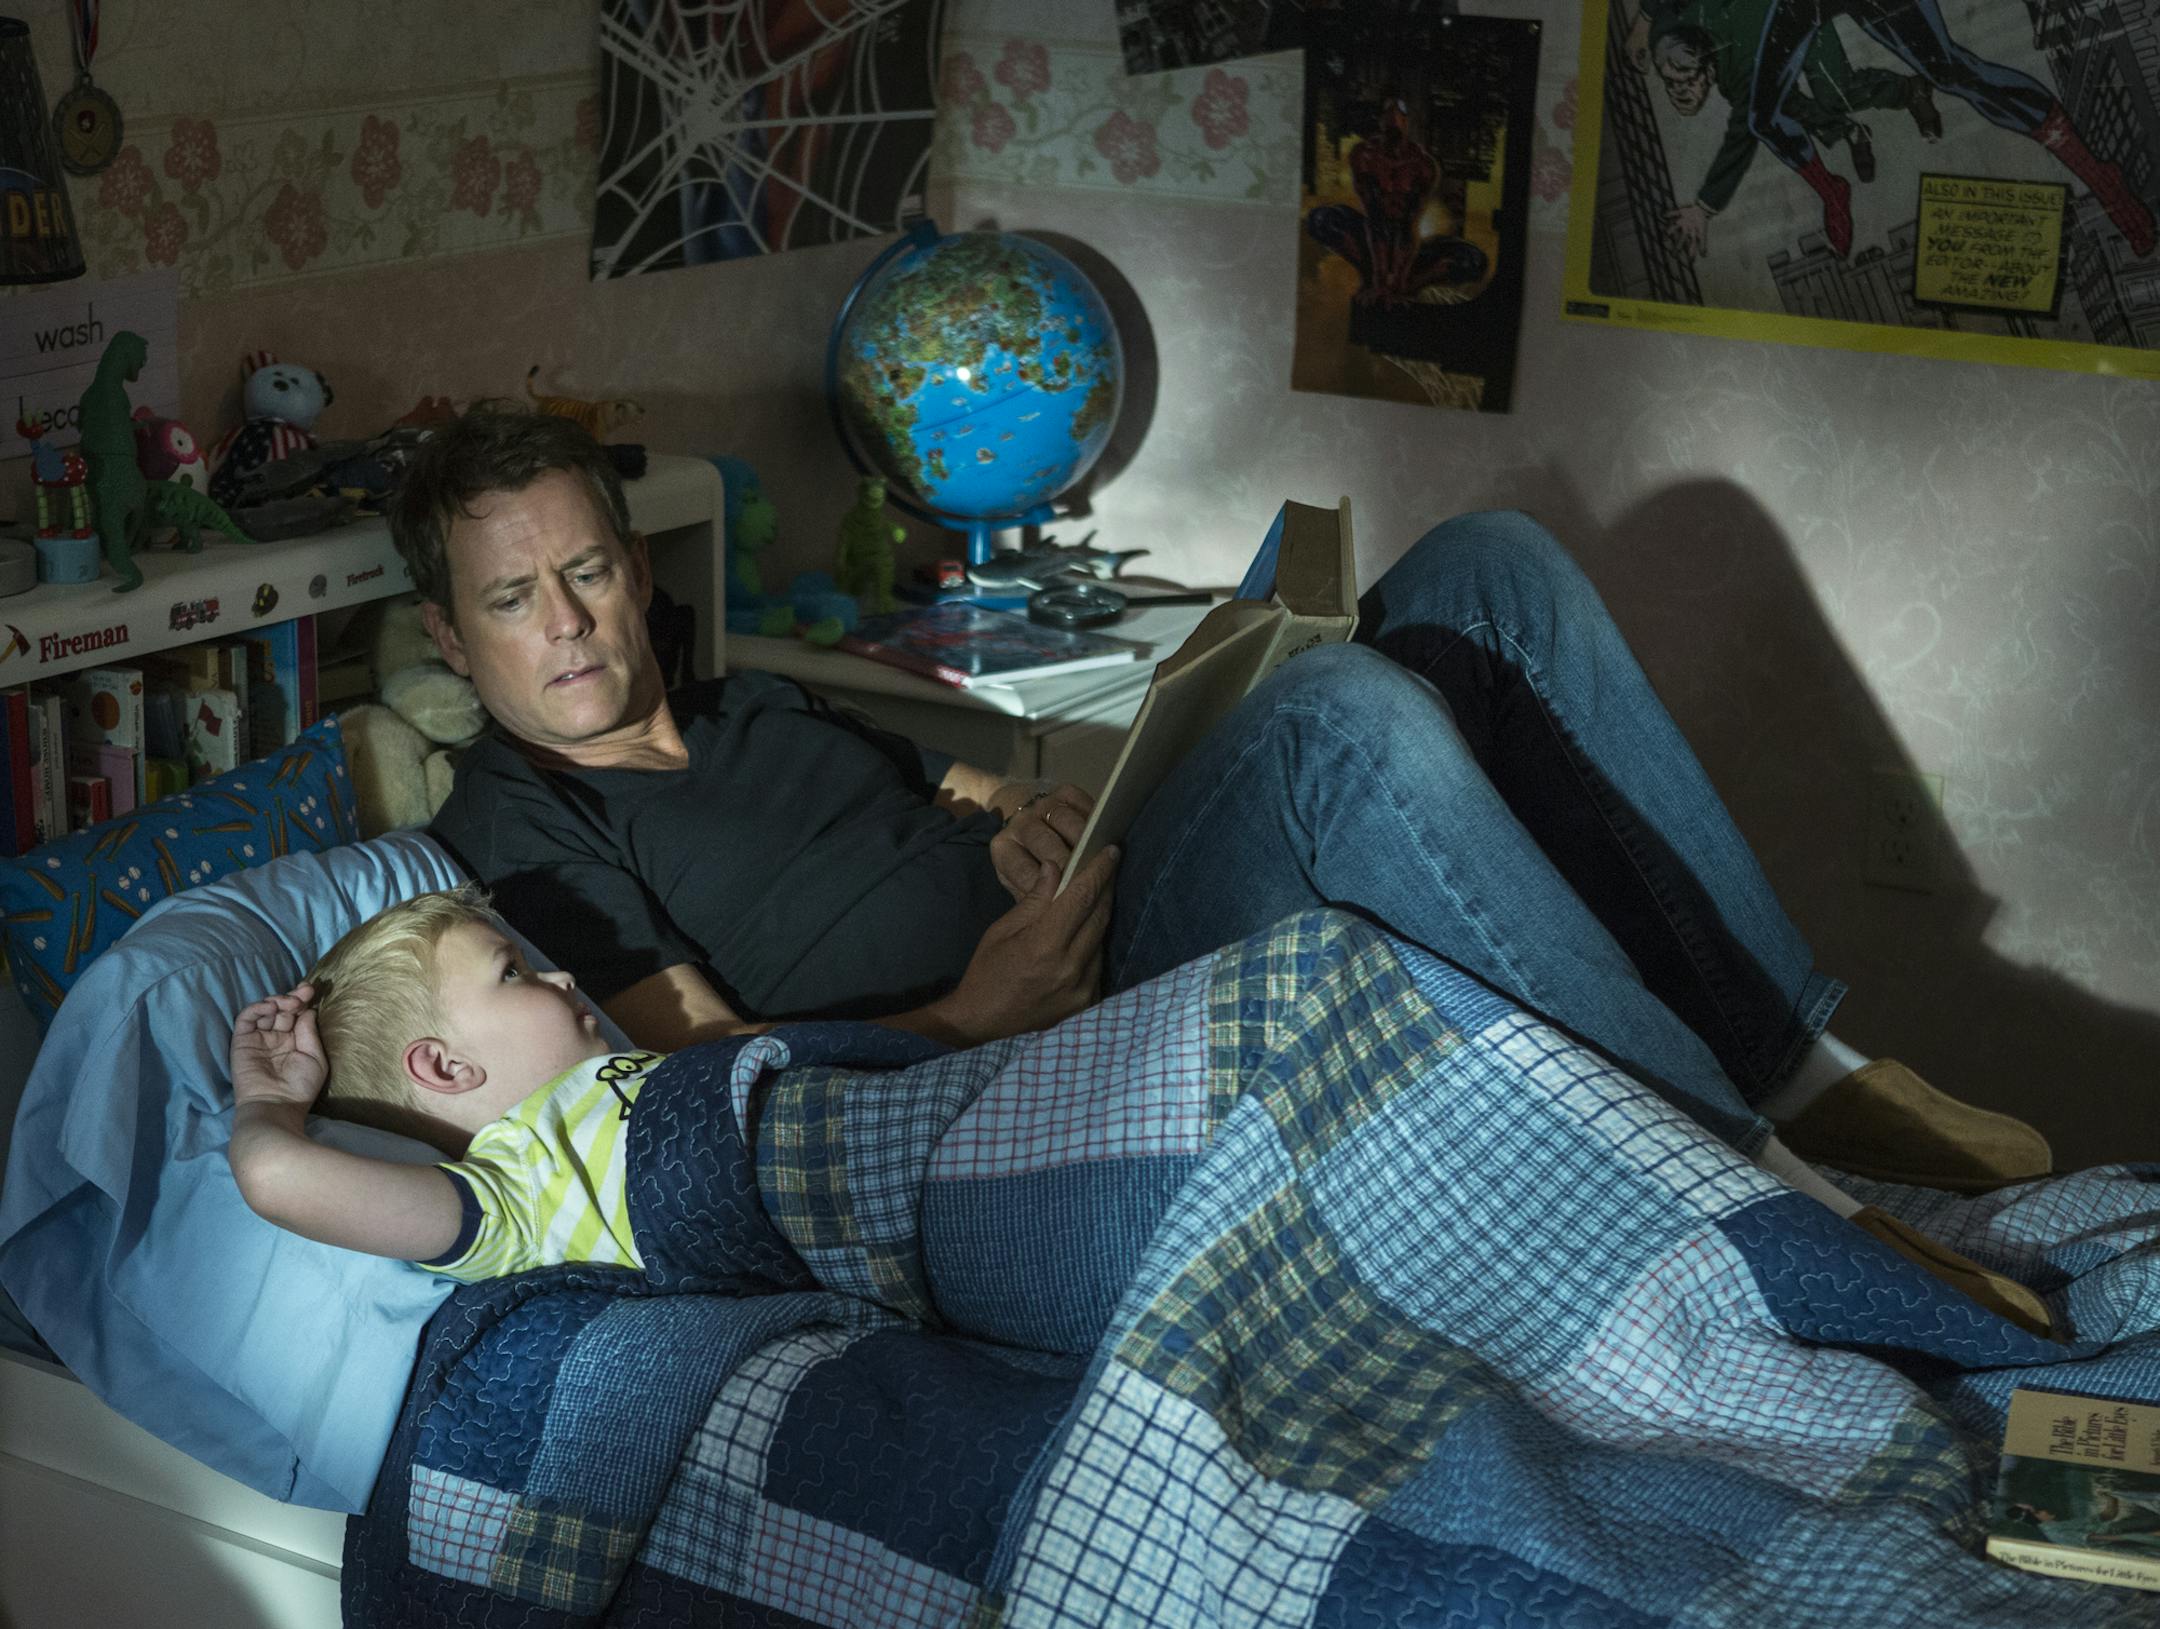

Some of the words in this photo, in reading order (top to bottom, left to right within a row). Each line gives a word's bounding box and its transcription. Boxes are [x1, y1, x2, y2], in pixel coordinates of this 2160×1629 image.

[1924, 181, 1959, 197] ALSO
[1963, 185, 1977, 198] IN
[1982, 186, 2015, 201] THIS
[1, 192, 68, 238] DER
[1931, 207, 1955, 220] AN
[1959, 208, 2049, 225] IMPORTANT
[1935, 224, 2017, 242] MESSAGE
[1927, 236, 1966, 252] YOU
[1969, 243, 2015, 256] FROM
[2020, 247, 2050, 260] THE
[1951, 271, 1980, 285] THE
[1983, 273, 2033, 288] NEW
[34, 302, 103, 353] wash
[38, 624, 130, 664] Fireman
[346, 564, 384, 588] Firetruck
[2105, 1407, 2137, 1426] Eyes
[2051, 1416, 2077, 1439] Bible
[2076, 1412, 2104, 1448] Pictures
[2103, 1426, 2128, 1449] Little
[2050, 1439, 2075, 1456] The
[2077, 1448, 2100, 1458] in
[2101, 1448, 2126, 1462] for
[1999, 1551, 2016, 1563] The
[2018, 1554, 2042, 1566] Bible
[2044, 1558, 2054, 1568] in
[2055, 1559, 2094, 1574] Pictures
[2110, 1567, 2135, 1581] Little
